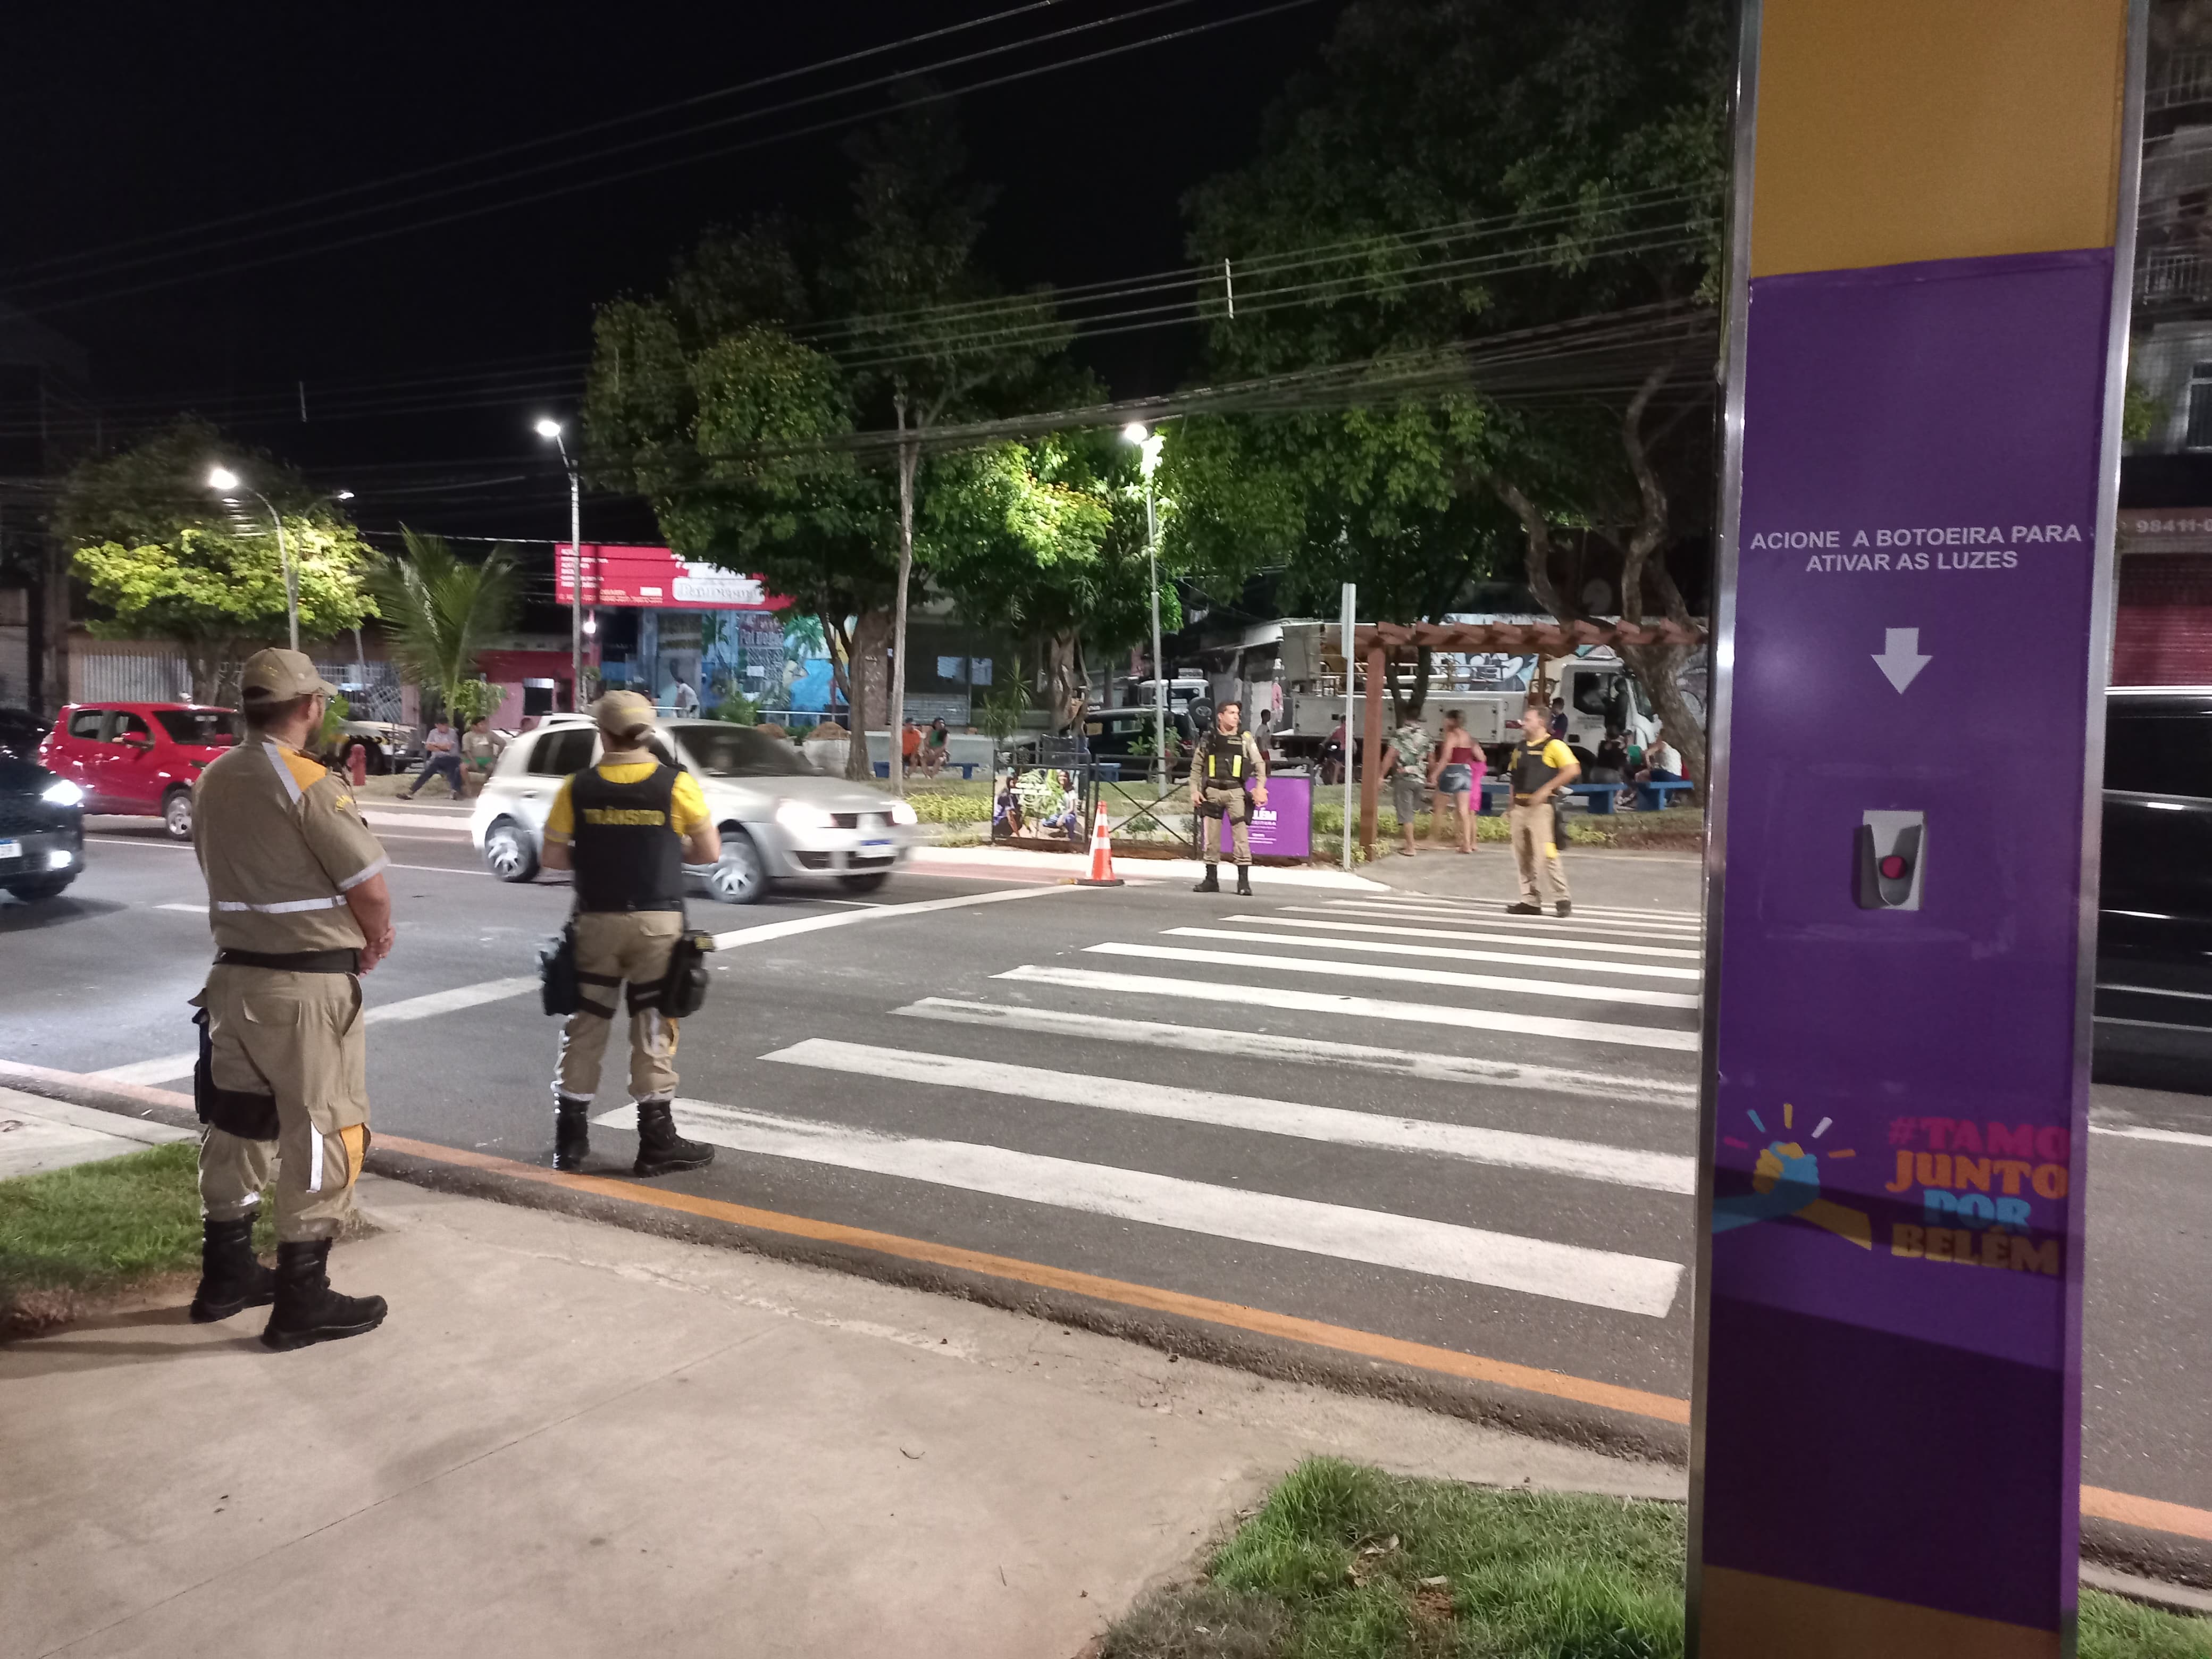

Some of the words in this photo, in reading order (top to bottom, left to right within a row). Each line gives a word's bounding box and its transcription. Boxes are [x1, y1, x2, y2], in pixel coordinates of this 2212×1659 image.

[1750, 531, 1840, 549] ACIONE
[1852, 530, 1870, 547] A
[1876, 526, 2005, 547] BOTOEIRA
[2012, 524, 2081, 543] PARA
[1806, 554, 1890, 572] ATIVAR
[1896, 552, 1929, 570] AS
[1938, 551, 2017, 569] LUZES
[1888, 1116, 2069, 1161] #TAMO
[1885, 1150, 2068, 1200] JUNTO
[1923, 1189, 2031, 1235] POR
[1891, 1224, 2058, 1275] BELÉM
